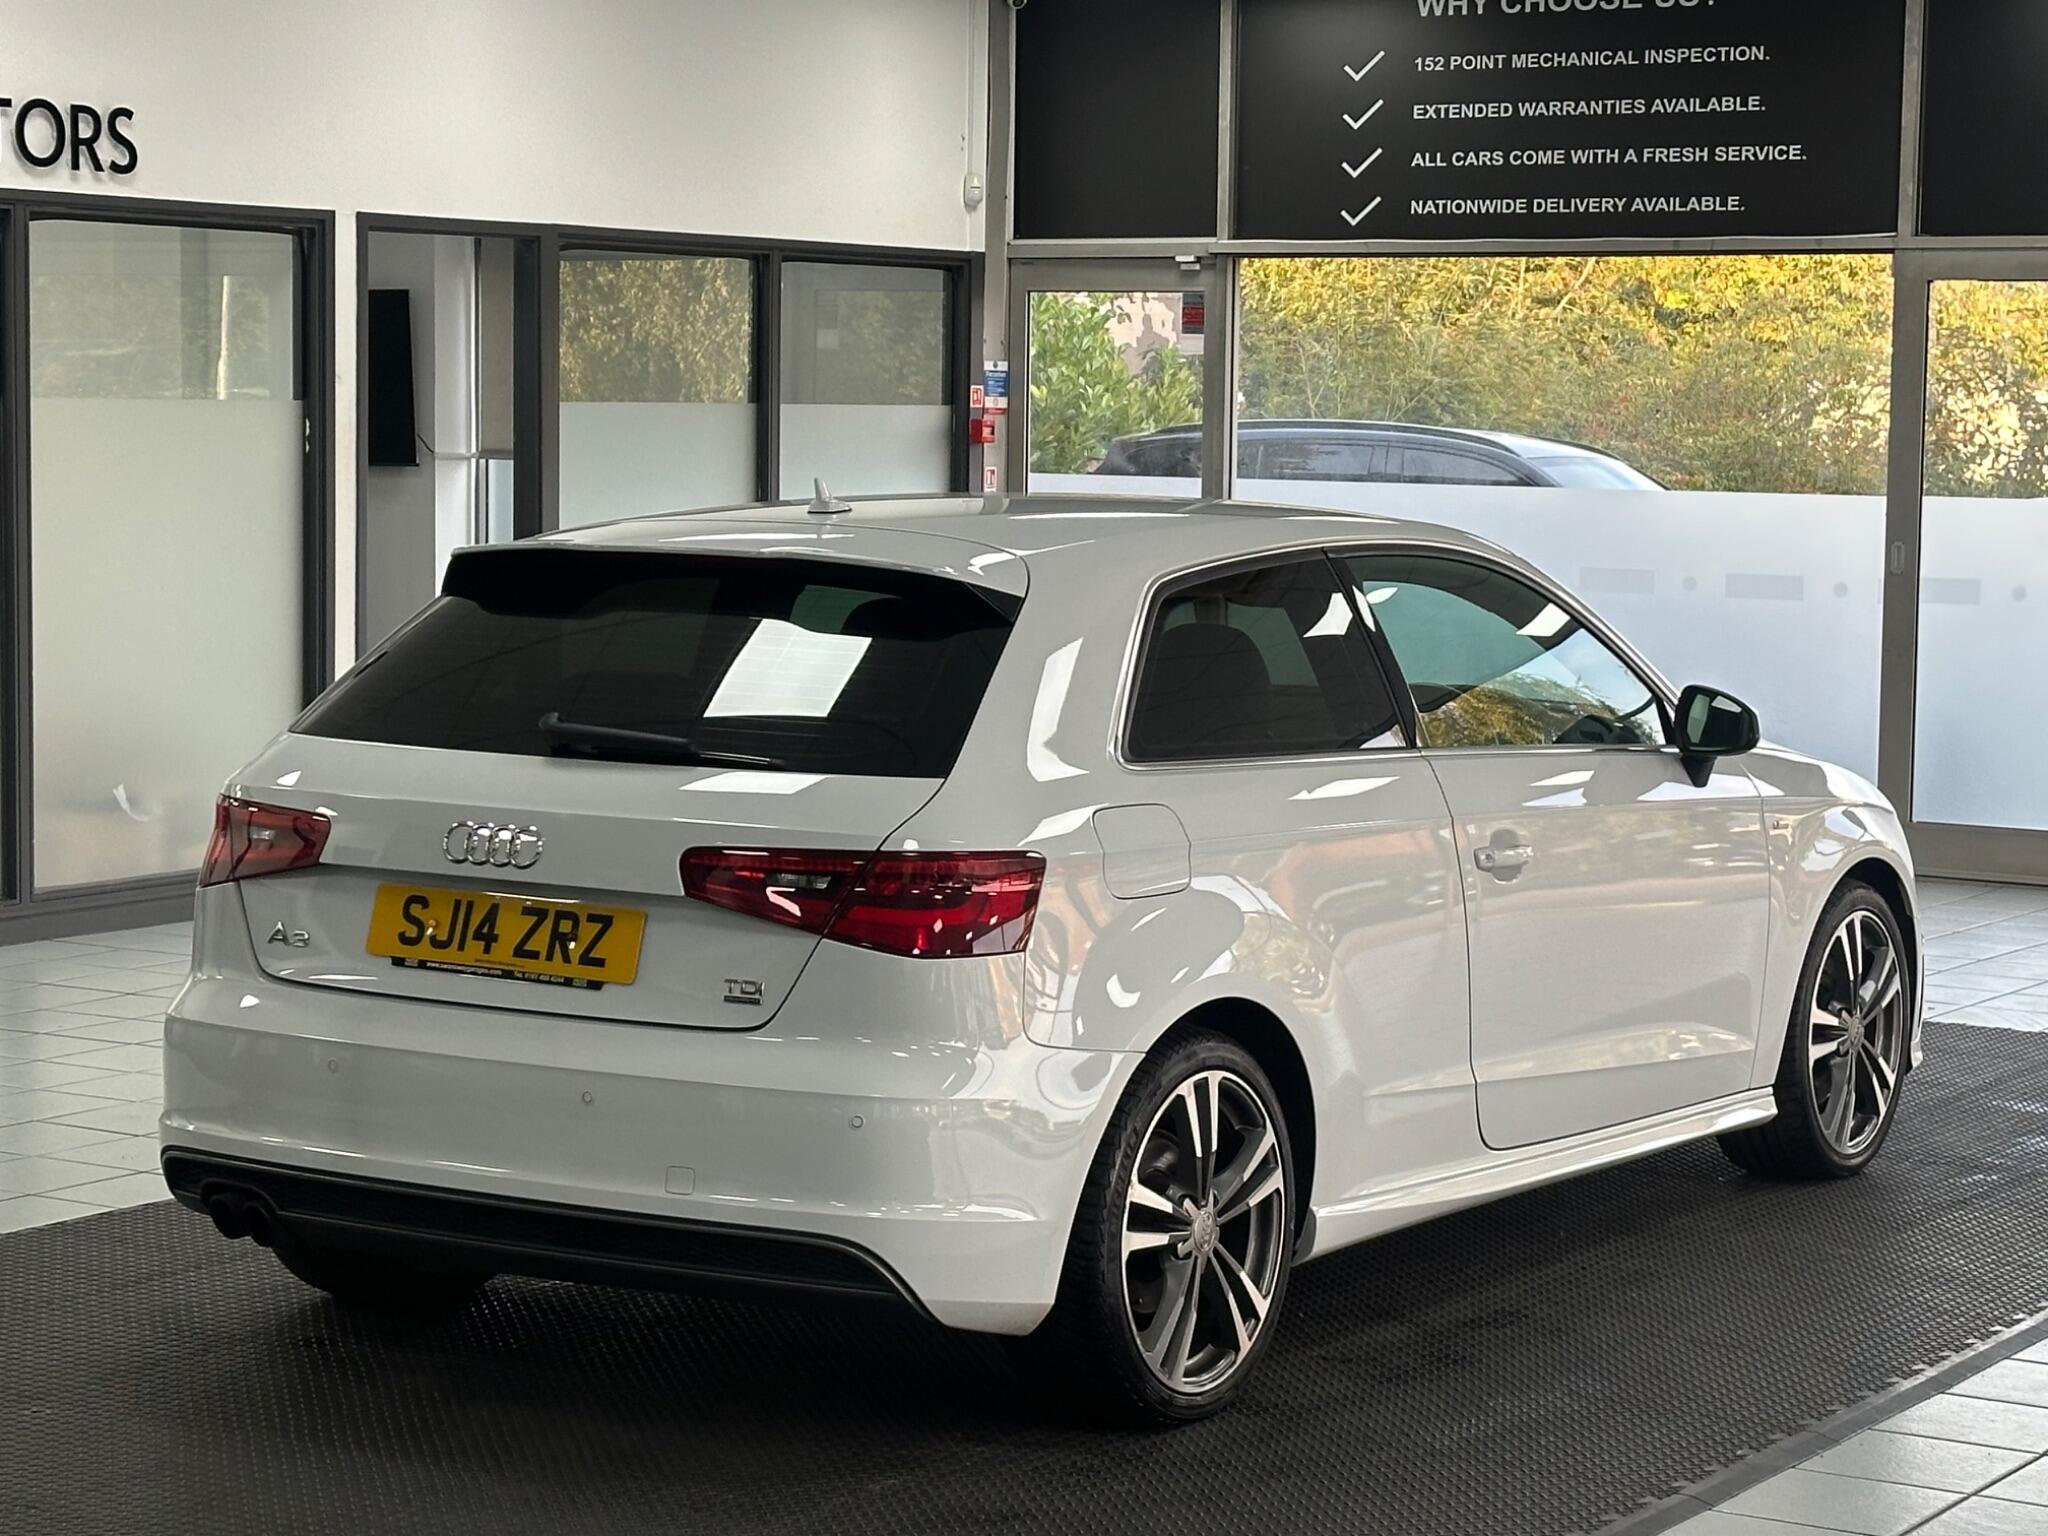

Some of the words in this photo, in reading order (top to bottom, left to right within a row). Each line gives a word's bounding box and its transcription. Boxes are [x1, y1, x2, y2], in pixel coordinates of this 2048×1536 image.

[1417, 0, 1486, 16] WHY
[1414, 56, 1444, 72] 152
[1449, 54, 1507, 71] POINT
[1511, 50, 1640, 69] MECHANICAL
[1644, 45, 1771, 64] INSPECTION.
[1412, 102, 1513, 120] EXTENDED
[1517, 98, 1646, 117] WARRANTIES
[1650, 95, 1766, 114] AVAILABLE.
[0, 97, 138, 175] ORS
[1410, 151, 1448, 167] ALL
[1451, 150, 1504, 167] CARS
[1509, 149, 1566, 166] COME
[1570, 148, 1619, 164] WITH
[1623, 148, 1638, 164] A
[1642, 146, 1709, 163] FRESH
[1714, 144, 1807, 162] SERVICE.
[1410, 198, 1528, 215] NATIONWIDE
[1533, 197, 1627, 213] DELIVERY
[1630, 195, 1745, 212] AVAILABLE.
[266, 920, 311, 948] A3
[398, 894, 501, 956] SJ14
[512, 905, 614, 968] ZRZ
[723, 978, 766, 997] TDI
